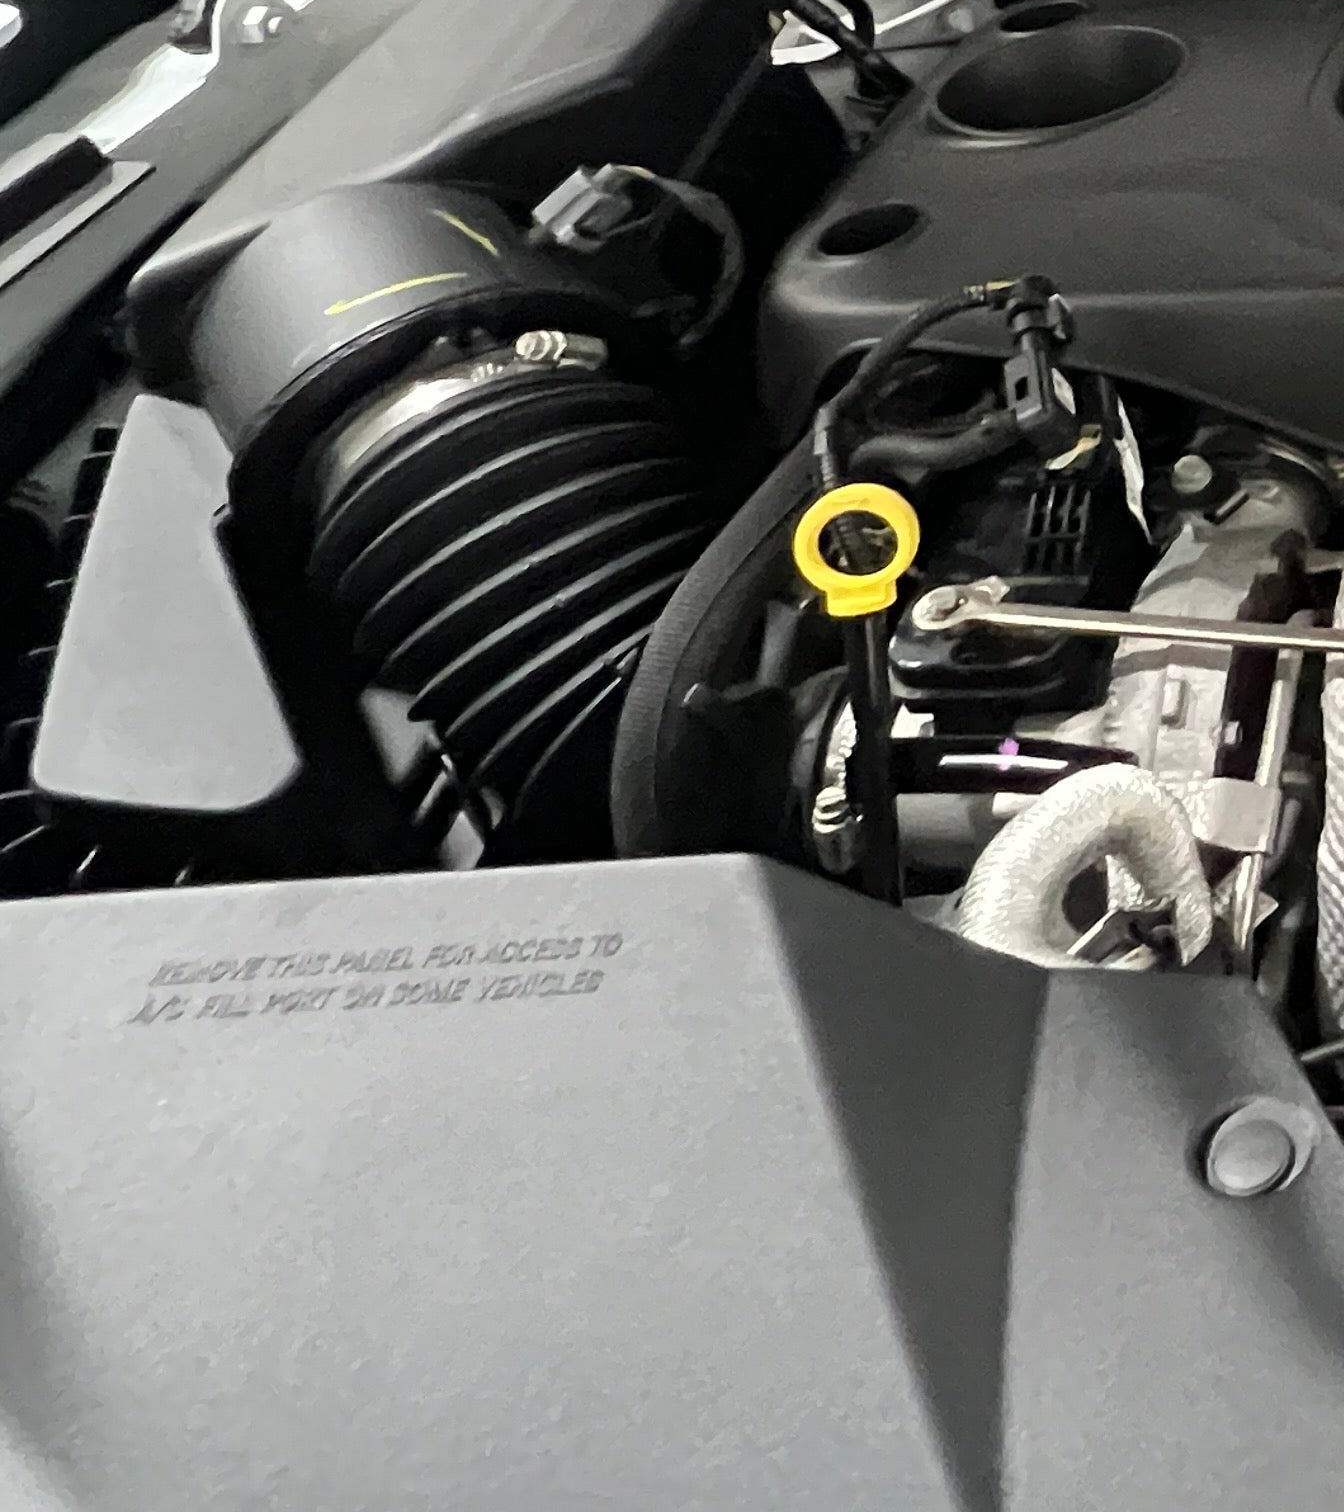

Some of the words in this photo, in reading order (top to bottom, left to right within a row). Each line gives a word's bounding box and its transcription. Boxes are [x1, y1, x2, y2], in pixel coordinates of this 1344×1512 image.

[150, 956, 267, 986] REMOVE
[268, 951, 331, 978] THIS
[329, 945, 414, 975] PANEL
[421, 942, 477, 969] FOR
[477, 936, 583, 965] ACCESS
[587, 931, 624, 959] TO
[130, 993, 188, 1024] A/C
[193, 993, 252, 1020] FILL
[259, 985, 341, 1015] PORT
[341, 982, 386, 1012] ON
[386, 977, 473, 1008] SOME
[473, 968, 606, 1003] VEHICLES
